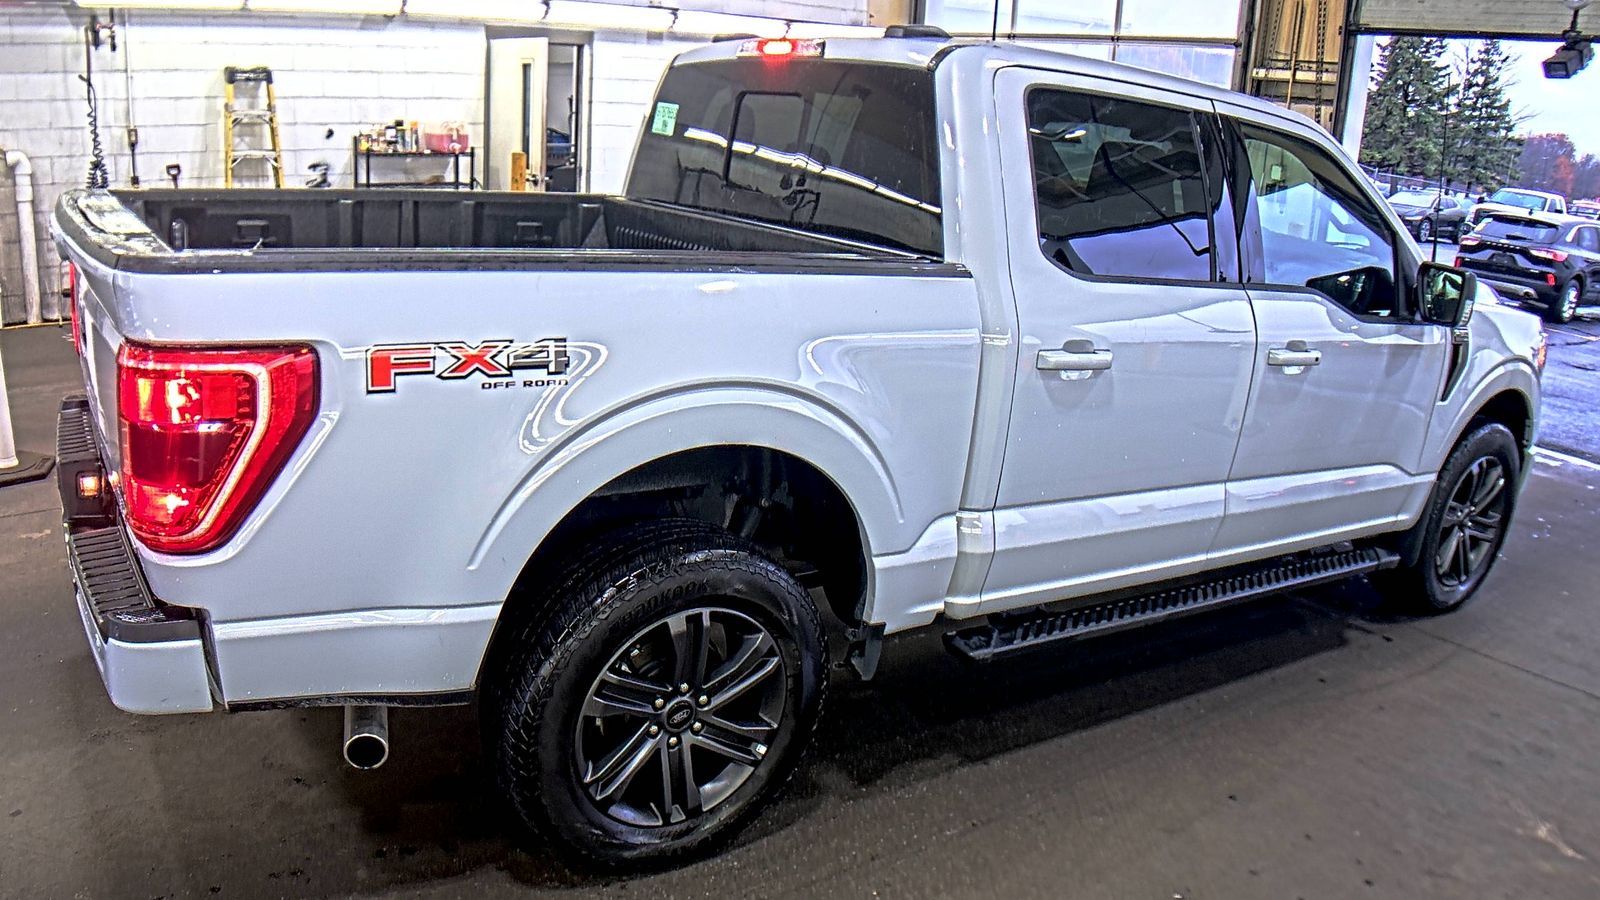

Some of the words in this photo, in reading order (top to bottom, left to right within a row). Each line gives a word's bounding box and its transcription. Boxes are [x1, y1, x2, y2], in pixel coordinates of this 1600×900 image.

[366, 337, 569, 394] FX4
[481, 381, 517, 390] OFF
[523, 379, 569, 388] ROAD
